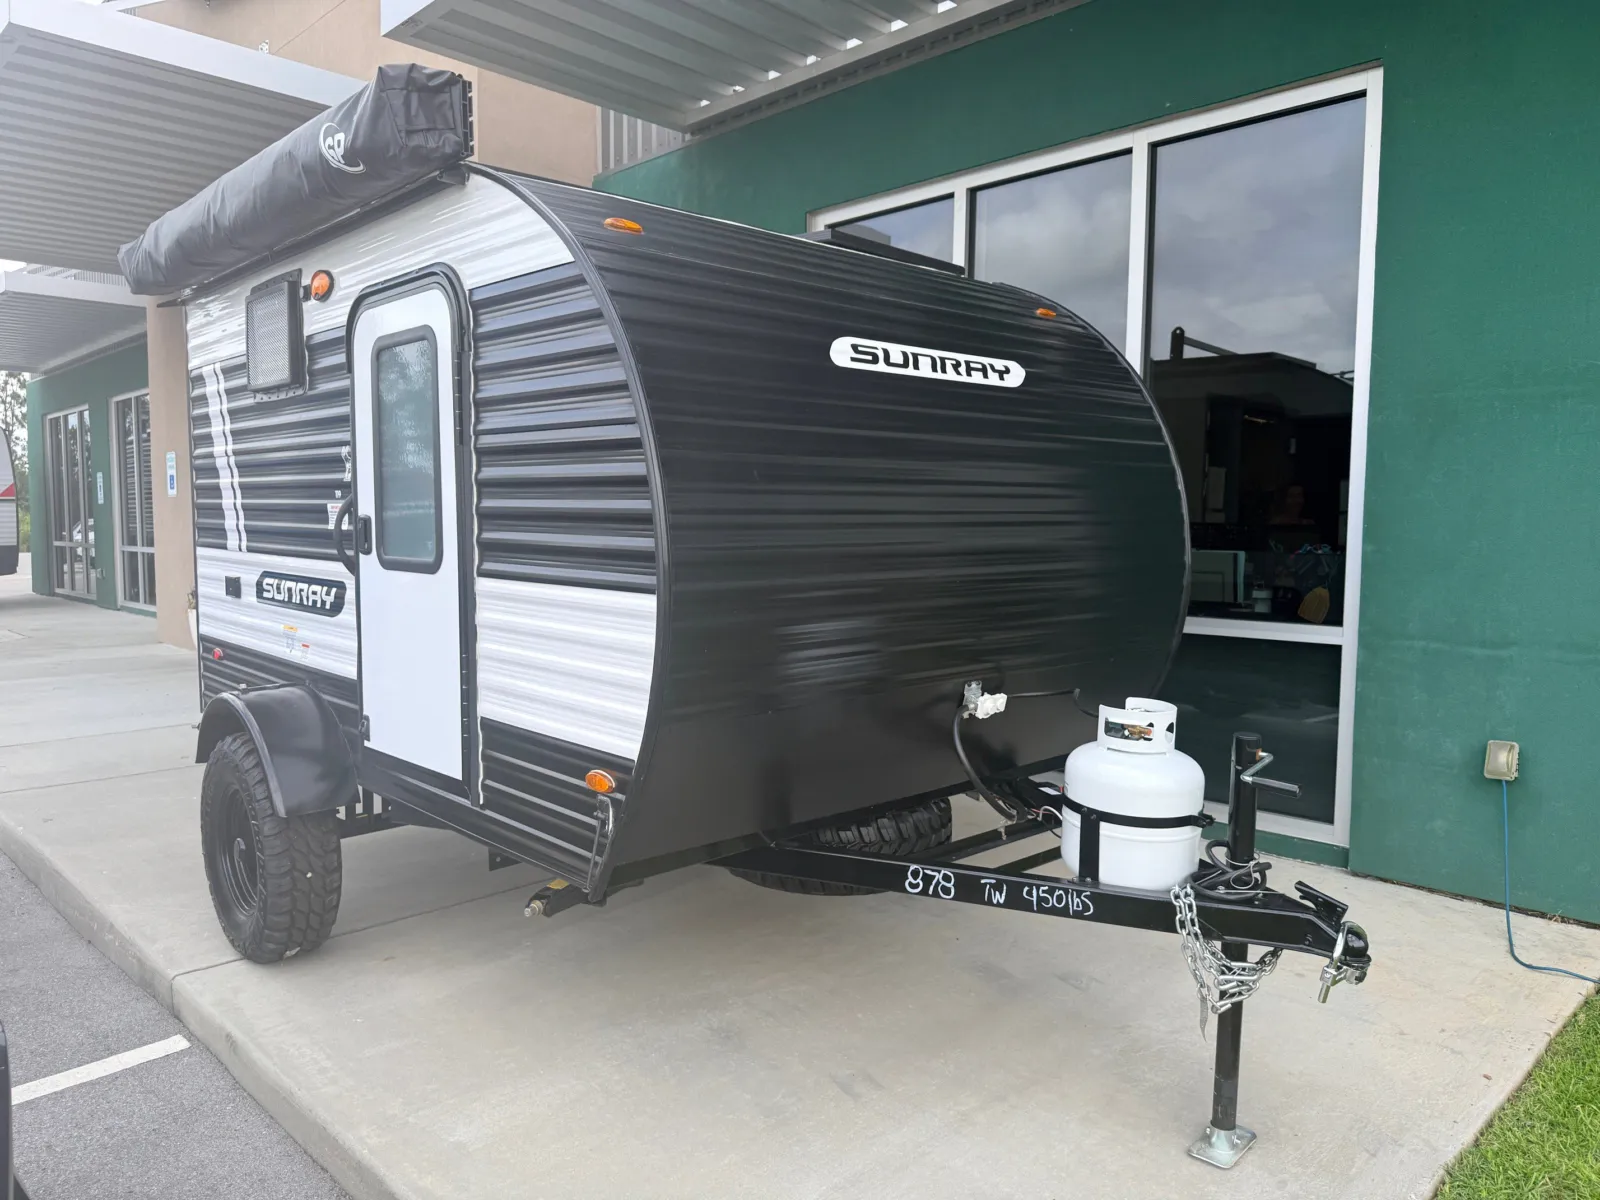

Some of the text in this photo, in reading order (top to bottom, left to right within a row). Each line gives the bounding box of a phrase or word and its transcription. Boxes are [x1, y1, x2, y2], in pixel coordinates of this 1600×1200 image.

[850, 343, 1011, 381] SUNRAY
[262, 578, 337, 610] SUNRAY
[905, 865, 955, 899] 878
[981, 879, 1007, 905] TW
